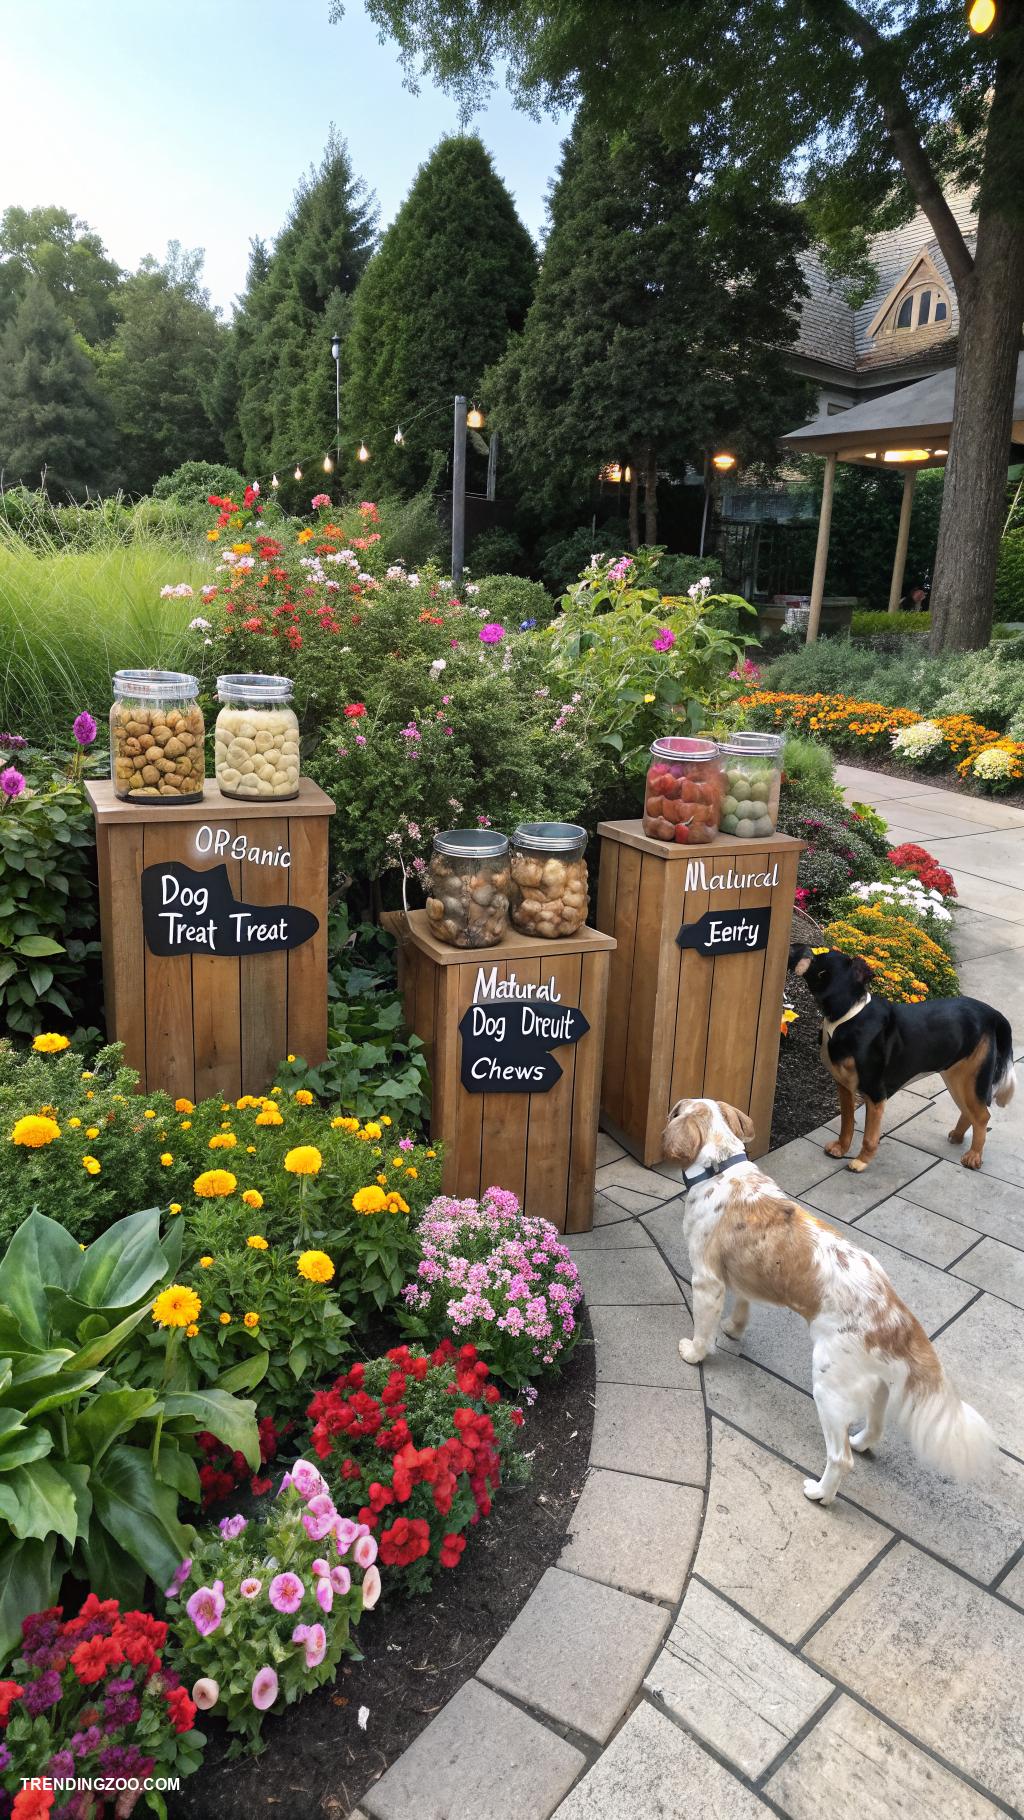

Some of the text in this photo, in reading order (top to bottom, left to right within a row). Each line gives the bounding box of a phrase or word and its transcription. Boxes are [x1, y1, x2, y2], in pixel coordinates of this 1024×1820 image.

[161, 875, 208, 915] Dog
[158, 912, 288, 950] Treat Treat
[472, 1007, 506, 1042] Dog
[471, 1057, 546, 1080] Chews
